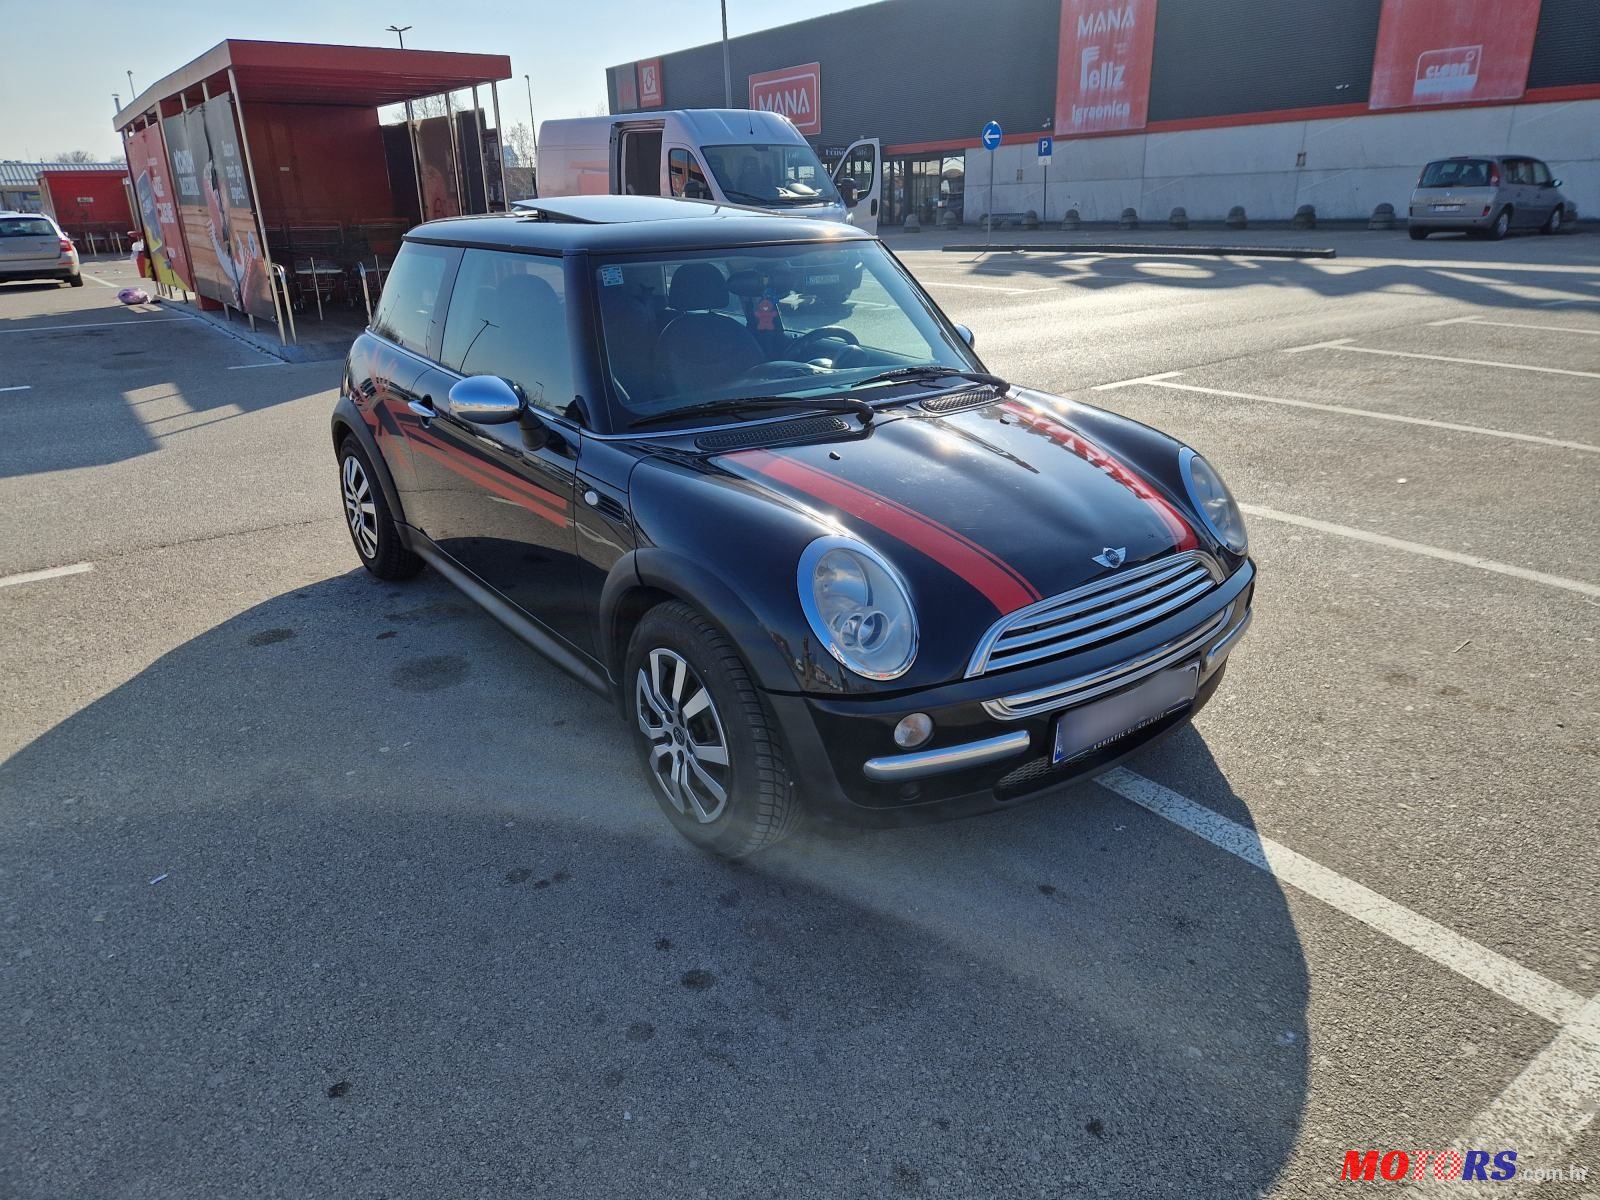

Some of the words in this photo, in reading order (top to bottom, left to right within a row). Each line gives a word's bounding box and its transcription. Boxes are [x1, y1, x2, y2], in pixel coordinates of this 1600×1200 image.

[1078, 6, 1136, 37] MANA
[1080, 46, 1126, 91] Feliz
[758, 87, 810, 116] MANA
[1041, 140, 1049, 153] P
